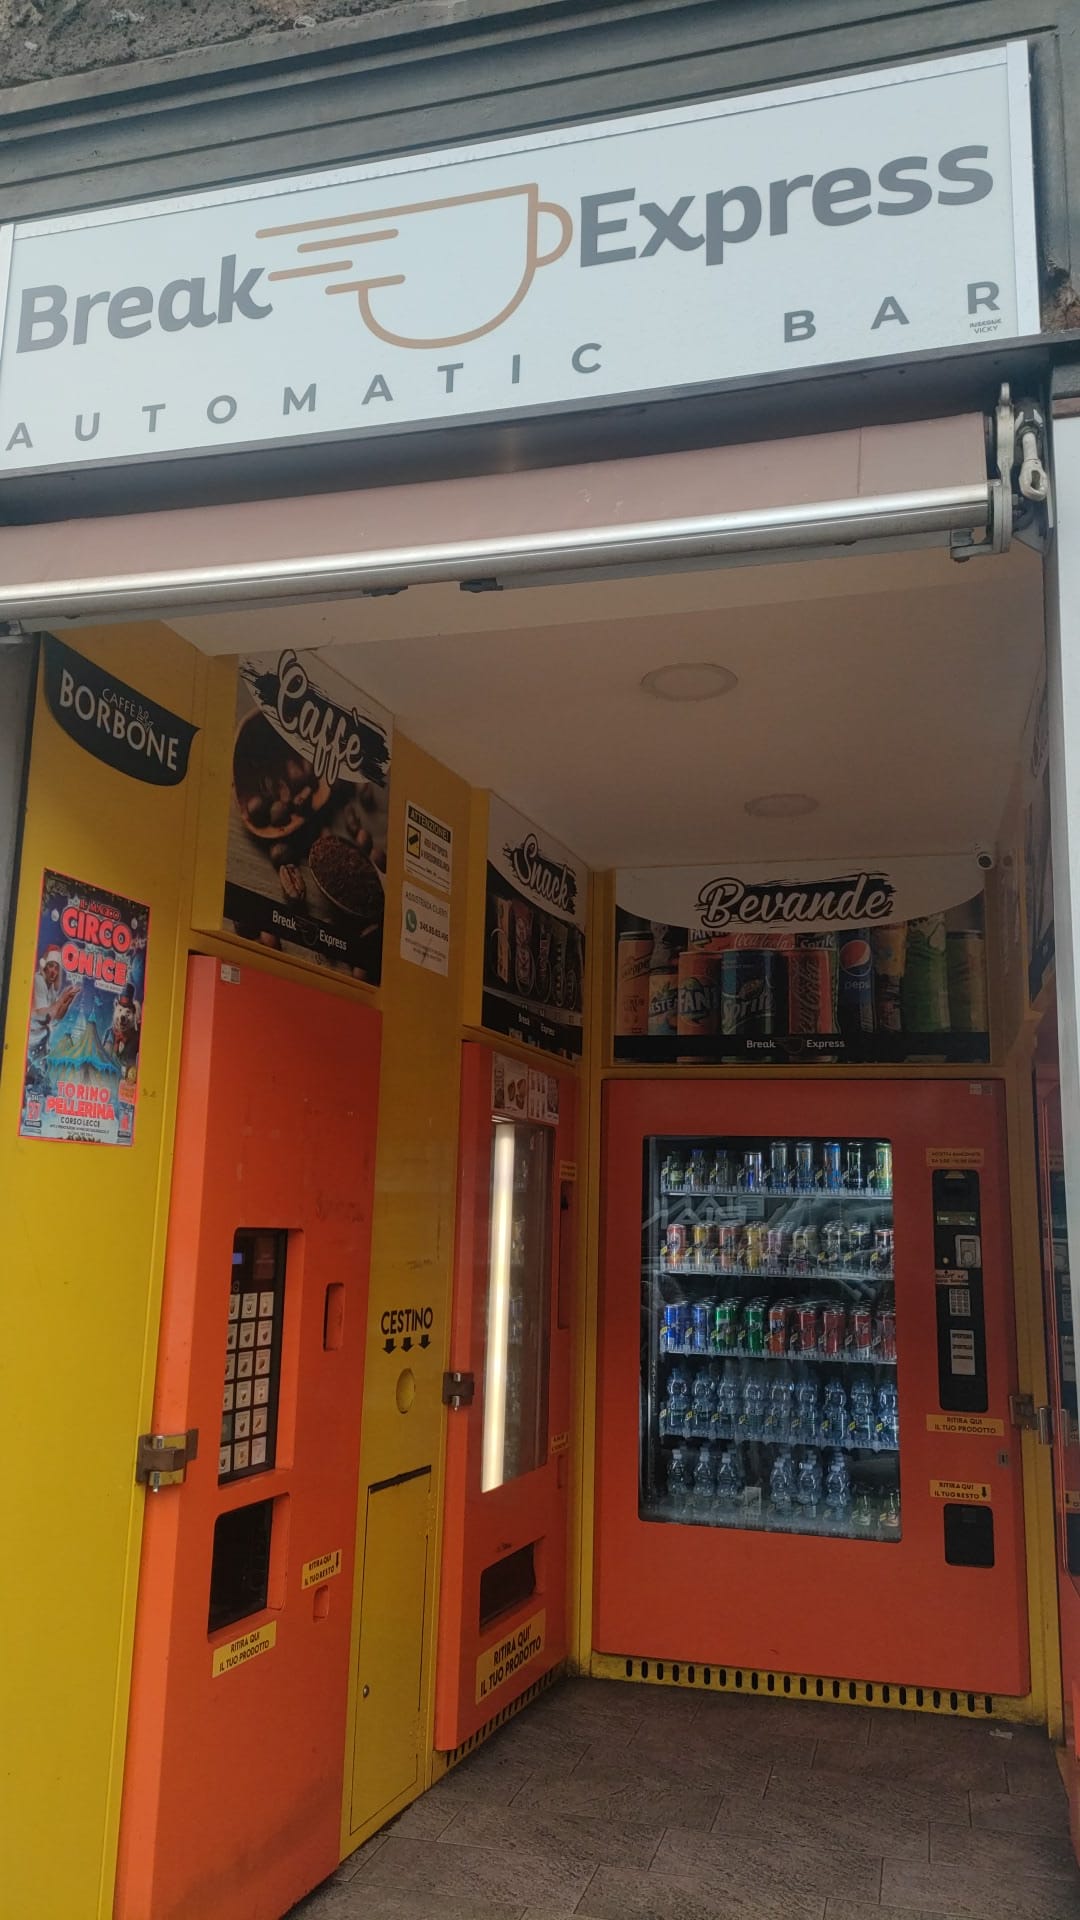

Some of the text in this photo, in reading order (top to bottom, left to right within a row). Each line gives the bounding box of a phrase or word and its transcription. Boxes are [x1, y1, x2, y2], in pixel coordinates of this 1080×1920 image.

[15, 144, 995, 354] Break Express
[974, 325, 999, 334] VICKY
[5, 281, 1001, 452] AUTOMATIC BAR
[59, 668, 179, 771] BORBONE
[513, 833, 569, 908] Snack
[699, 872, 893, 928] Bevande
[61, 906, 132, 953] CIRCO
[272, 910, 348, 951] Break Express
[61, 943, 127, 986] ON ICE
[746, 1039, 846, 1050] Break Express
[57, 1081, 110, 1103] TORINO
[45, 1096, 115, 1121] PELLERINA
[60, 1116, 82, 1127] CORSO
[381, 1306, 434, 1335] CESTINO
[947, 1416, 968, 1424] RITIRA
[958, 1425, 996, 1434] PRODOTTO
[939, 1481, 960, 1489] RITIRA
[942, 1490, 956, 1498] TUO
[956, 1491, 980, 1500] RESTO
[309, 1558, 323, 1571] RITIRA
[309, 1573, 319, 1584] TUO
[320, 1564, 335, 1578] RESTO
[219, 1639, 270, 1672] IL TUO PRODOTTO
[230, 1637, 249, 1653] RITIRA
[493, 1636, 517, 1666] RITIRA
[480, 1635, 542, 1697] IL TUO PRODOTTO
